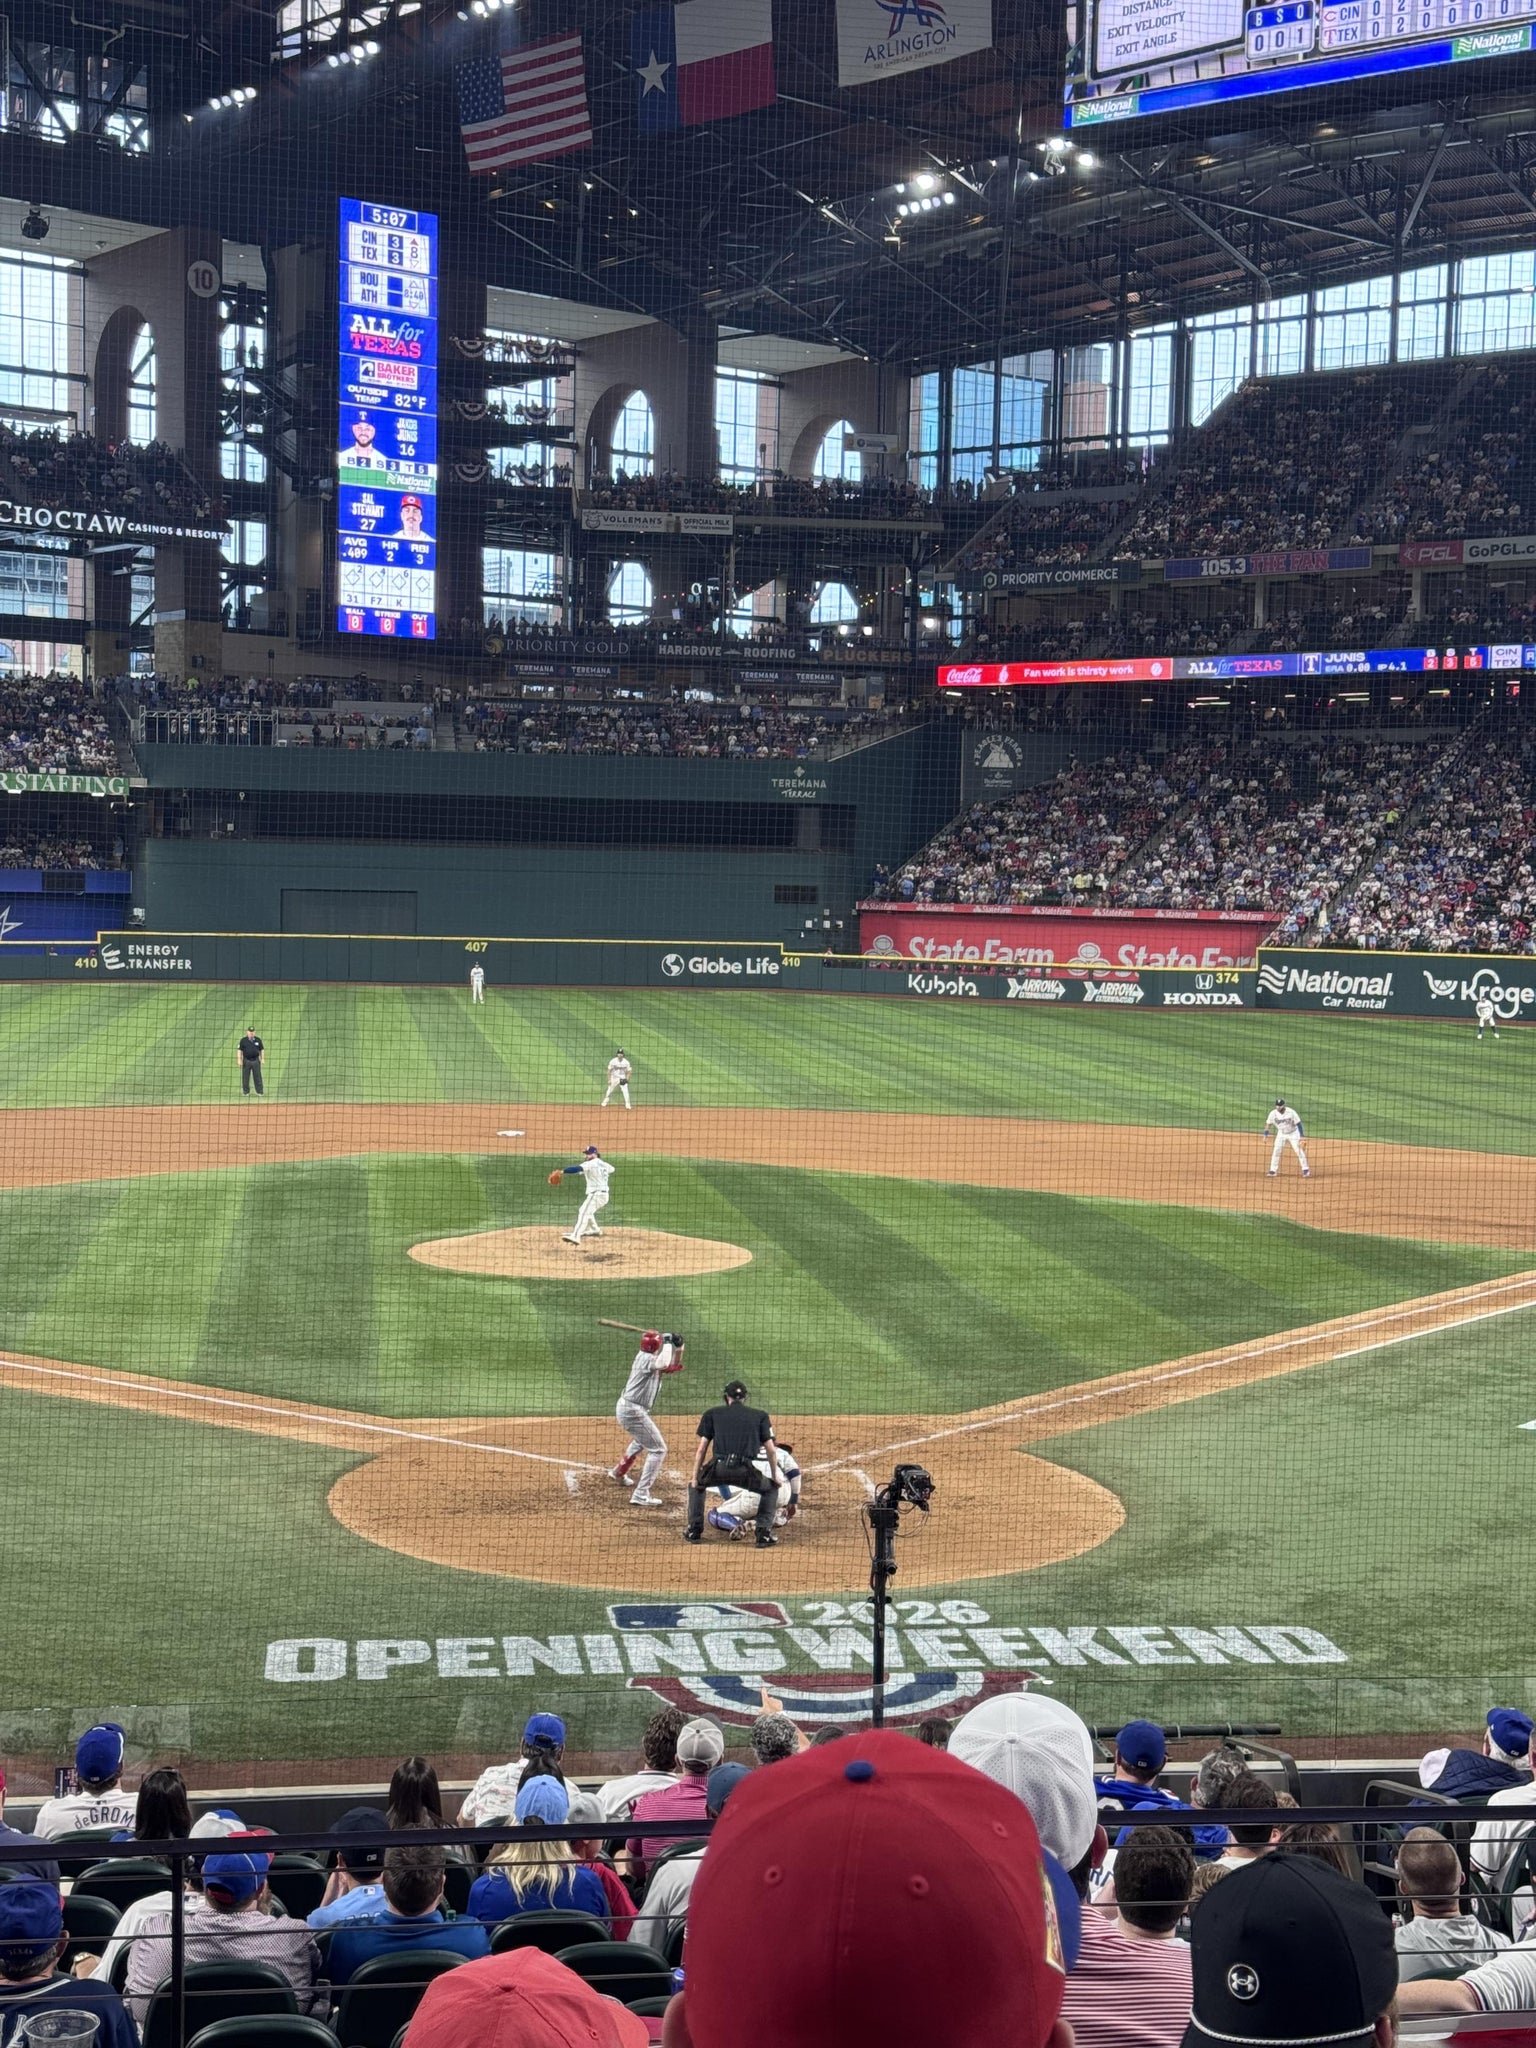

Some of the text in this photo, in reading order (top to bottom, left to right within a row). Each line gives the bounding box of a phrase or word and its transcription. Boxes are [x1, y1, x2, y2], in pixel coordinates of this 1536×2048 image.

[1122, 0, 1172, 17] DISTANCE
[1340, 5, 1360, 20] CIN
[1373, 0, 1381, 16] 0
[1255, 12, 1263, 27] B
[1276, 8, 1284, 23] S
[1338, 26, 1358, 42] TEX
[1372, 21, 1380, 37] 0
[1397, 17, 1404, 33] 2
[1423, 12, 1431, 29] 0
[1448, 7, 1456, 24] 0
[1474, 2, 1483, 19] 0
[1107, 11, 1186, 40] EXIT VELOCITY
[864, 23, 956, 64] ARLINGTON
[1115, 32, 1178, 57] EXIT ANGLE
[1254, 27, 1303, 51] 0 0 1
[1472, 29, 1523, 50] National
[1089, 98, 1133, 116] National
[372, 208, 407, 227] 5:07
[362, 229, 399, 248] CIN 3
[361, 245, 399, 264] TEX 3
[410, 246, 418, 259] 8
[191, 266, 213, 291] 10
[360, 271, 379, 287] HOU
[361, 288, 377, 304] ATH
[350, 313, 424, 349] ALL for
[350, 333, 421, 359] TEXAS
[377, 362, 415, 377] BAKER
[377, 372, 414, 384] BROTHERS
[347, 384, 388, 398] OUTSIDE
[354, 394, 381, 404] TEMP
[400, 443, 415, 457] 16
[347, 456, 355, 465] B
[376, 460, 384, 469] S
[405, 464, 414, 472] T
[397, 474, 431, 487] National
[362, 492, 374, 504] SAL
[352, 502, 384, 518] STEWART
[0, 500, 231, 541] CHOCTAW CASINOS & RESORTS
[360, 518, 376, 531] 27
[602, 514, 663, 525] VOLLEMAN'S
[683, 518, 712, 526] OFFICIAL
[344, 536, 429, 554] AVG HR RBI
[387, 551, 394, 562] 2
[416, 554, 424, 564] 3
[1418, 546, 1457, 561] PGL
[1201, 551, 1329, 576] 105.3 THE FAN
[1002, 568, 1118, 585] PRIORITY COMMERCE
[346, 594, 359, 603] 31
[345, 608, 366, 616] BALL
[411, 613, 428, 621] OUT
[351, 615, 424, 634] 0 0 1
[506, 638, 629, 655] PRIORITY GOLD
[658, 644, 796, 659] HARGROVE ROOFING
[1469, 647, 1478, 656] T
[1495, 648, 1518, 656] CIN
[823, 650, 913, 663] PLUCKERS
[1325, 652, 1366, 662] JUNIS
[1495, 659, 1518, 667] TEX
[514, 664, 554, 673] TEREMANA
[571, 666, 611, 674] TEREMANA
[1024, 664, 1134, 678] Fan work is thirsty work
[1188, 659, 1283, 676] ALL for TEXAS
[1325, 665, 1344, 673] ERA
[1388, 662, 1407, 671] 4.1
[740, 671, 779, 680] TEREMANA
[796, 673, 835, 681] TEREMANA
[15, 773, 125, 795] STAFFING
[771, 778, 827, 788] TEREMANA
[128, 944, 179, 956] ENERGY
[464, 941, 488, 953] 407
[75, 957, 98, 969] 410
[128, 959, 192, 970] TRANSFER
[688, 956, 780, 975] Globe Life
[781, 957, 800, 967] 410
[908, 974, 977, 996] Kubota
[1020, 979, 1058, 992] ARROW
[1216, 972, 1239, 985] 374
[1287, 968, 1391, 996] National
[1098, 982, 1138, 996] ARROW
[1163, 992, 1243, 1005] HONDA
[1322, 996, 1386, 1010] Car Rental
[800, 1599, 992, 1626] 2026
[263, 1625, 1350, 1683] OPENING WEEKEND
[74, 1806, 135, 1830] deGROM
